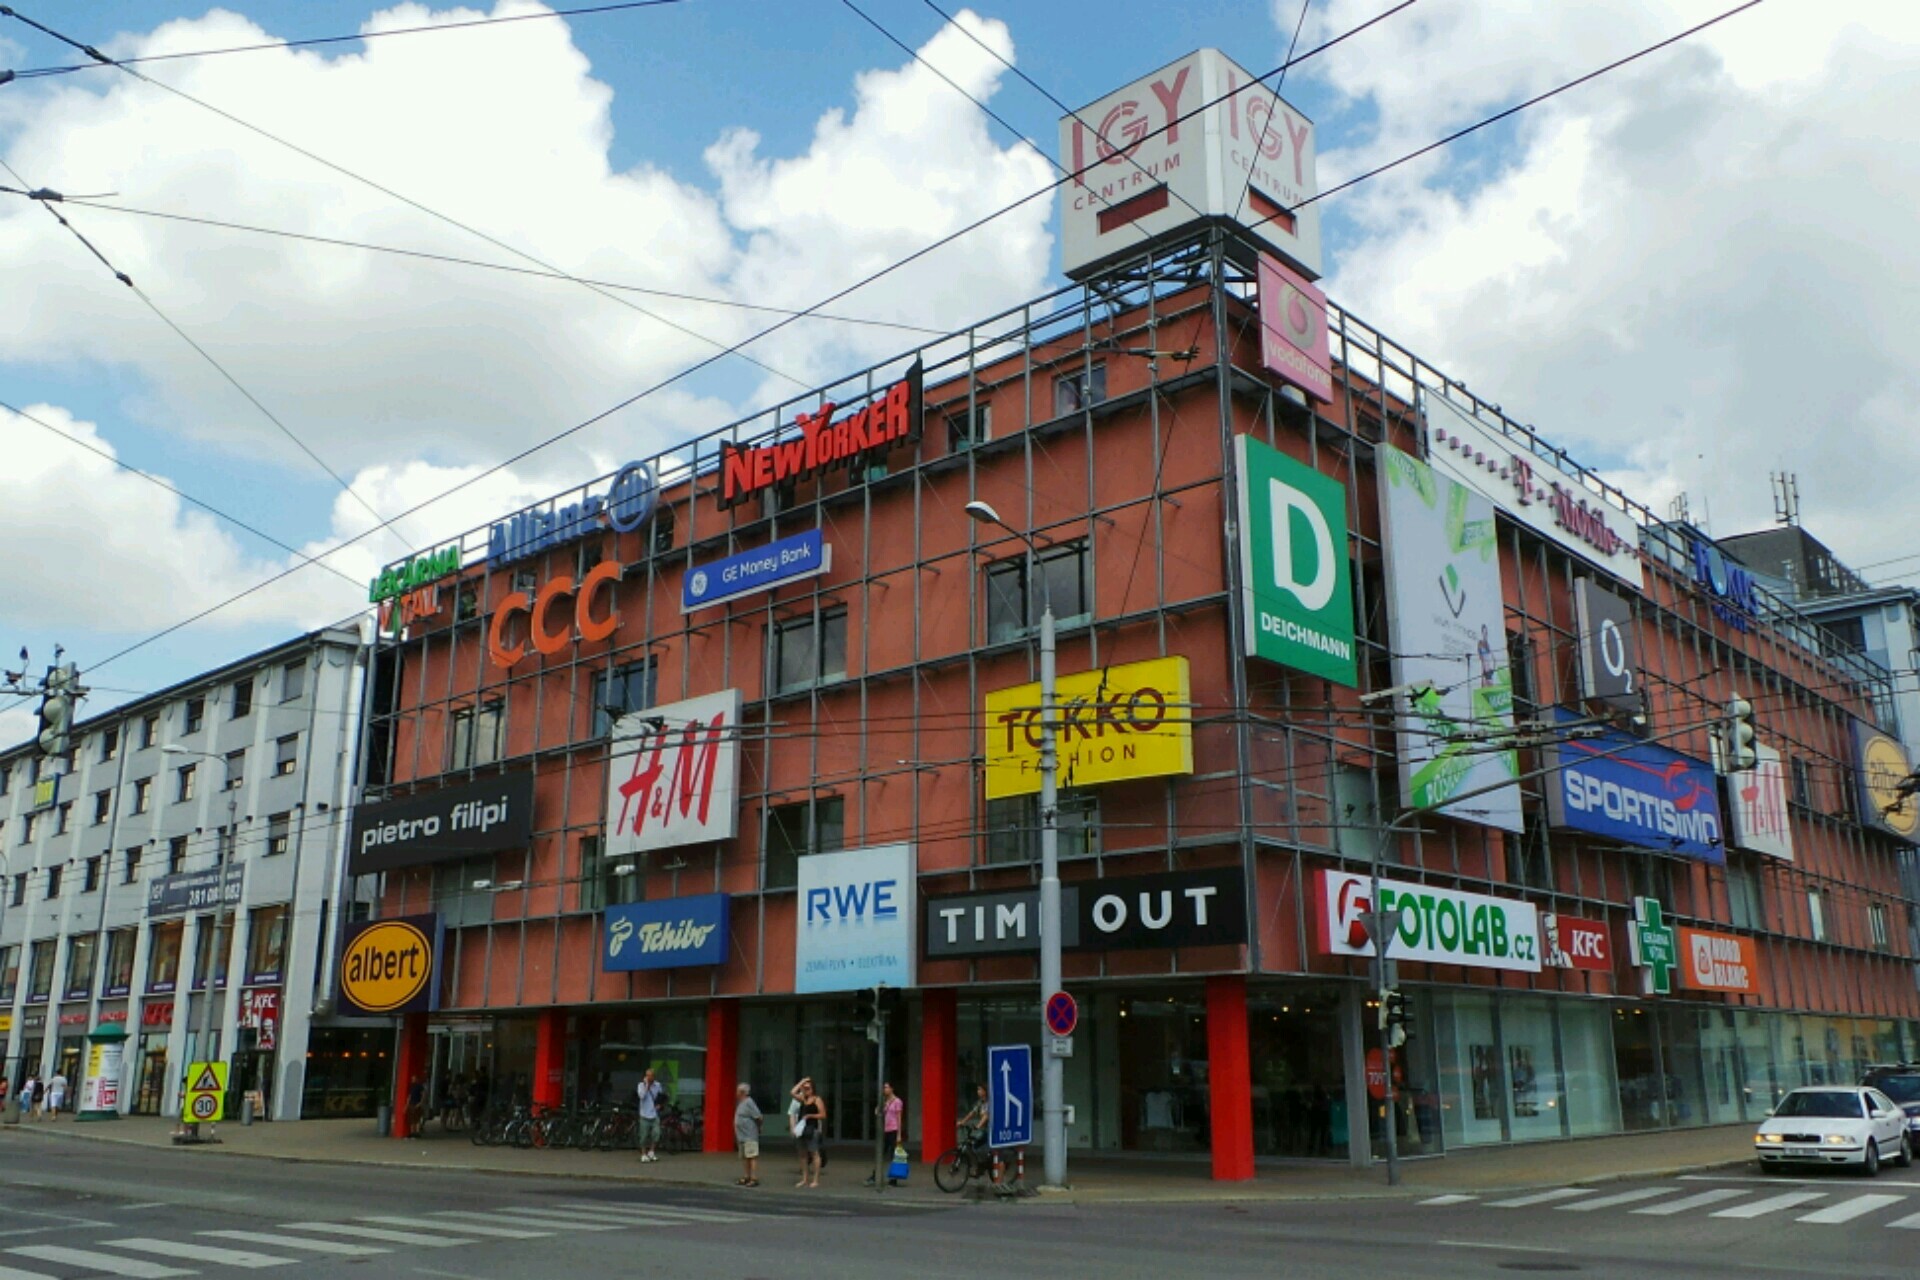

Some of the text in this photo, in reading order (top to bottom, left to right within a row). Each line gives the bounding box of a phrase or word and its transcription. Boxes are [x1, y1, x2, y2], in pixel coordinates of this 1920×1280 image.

[1072, 65, 1190, 188] IGY
[1228, 69, 1308, 187] IGY
[1073, 152, 1181, 210] CENTRUM
[1230, 149, 1304, 210] CENTRUM
[487, 494, 605, 569] Allianz
[722, 541, 811, 583] GE Money Bank
[489, 560, 623, 669] CCC
[1261, 611, 1350, 661] DEICHMANN
[616, 710, 725, 836] H&M
[361, 795, 508, 854] pietro filipi
[1565, 769, 1719, 845] SPORTISIMO
[1740, 761, 1786, 846] H&M
[807, 880, 898, 921] RWE
[940, 886, 1217, 943] TIM OUT
[349, 942, 420, 983] albert
[638, 918, 716, 954] Tchibo
[1572, 930, 1604, 959] KFC
[144, 1003, 174, 1025] KFC
[253, 993, 277, 1008] KFC
[197, 1100, 212, 1113] 30
[999, 1130, 1011, 1141] 100
